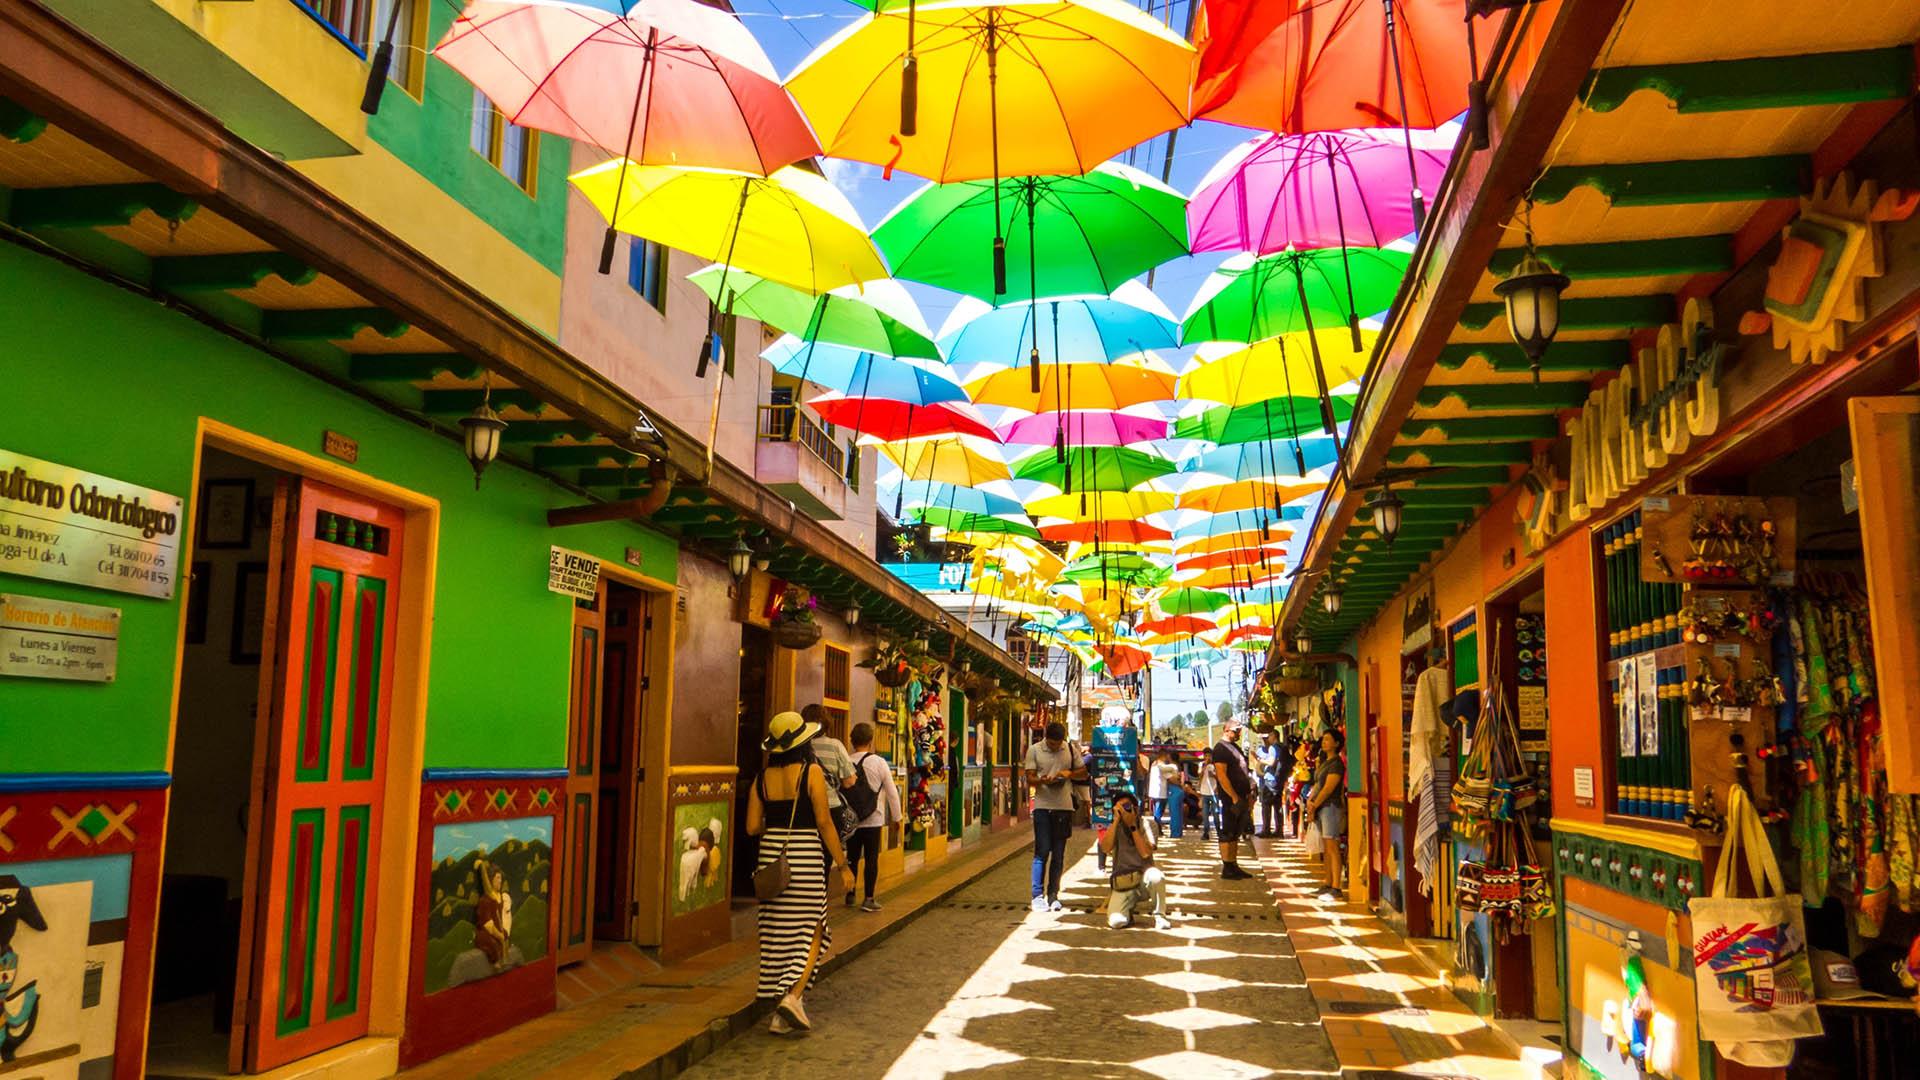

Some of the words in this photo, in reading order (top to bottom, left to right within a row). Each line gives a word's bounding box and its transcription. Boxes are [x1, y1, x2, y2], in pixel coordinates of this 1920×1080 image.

[0, 466, 64, 510] ultorio
[551, 550, 561, 565] SE
[564, 554, 600, 576] VENDE
[20, 636, 50, 651] Lunes
[52, 642, 59, 651] a
[61, 640, 97, 656] Viernes
